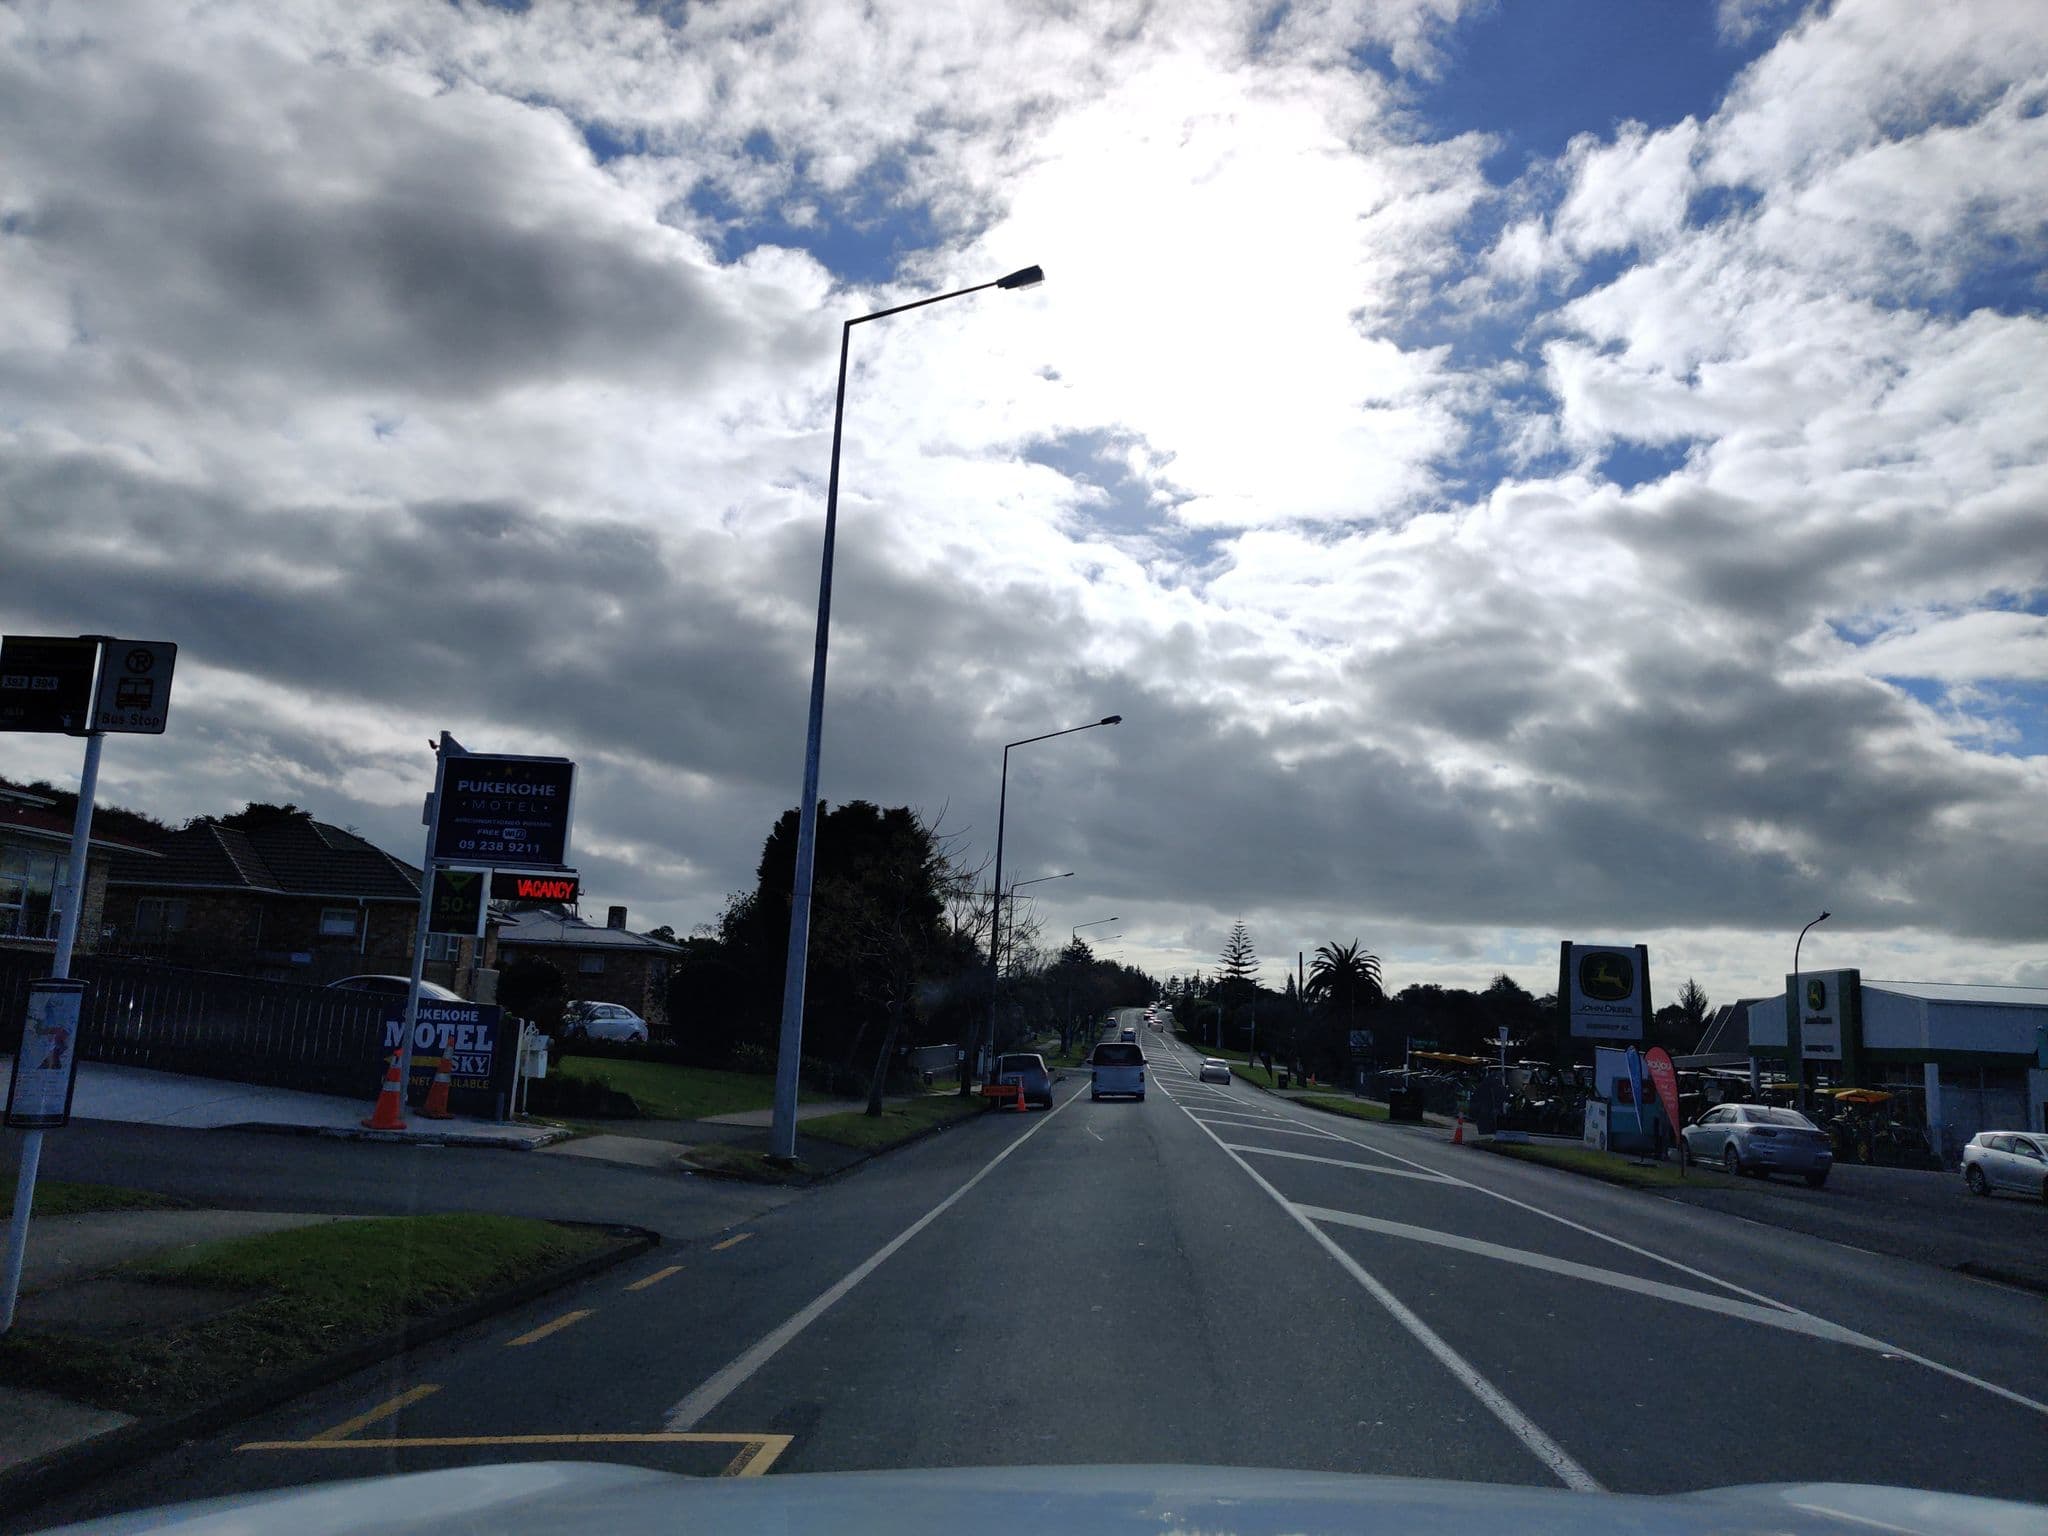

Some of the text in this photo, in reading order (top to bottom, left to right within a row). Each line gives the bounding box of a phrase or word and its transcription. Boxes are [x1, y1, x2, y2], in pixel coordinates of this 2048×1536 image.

[102, 713, 160, 728] Bus Stop
[457, 779, 557, 797] PUKEKOHE
[471, 799, 538, 814] MOTEL
[476, 828, 501, 837] FREE
[458, 840, 541, 854] 09 238 9211
[516, 878, 575, 900] VACANCY
[439, 896, 475, 913] 50+
[384, 1020, 493, 1051] MOTEL
[451, 1054, 489, 1074] SKY
